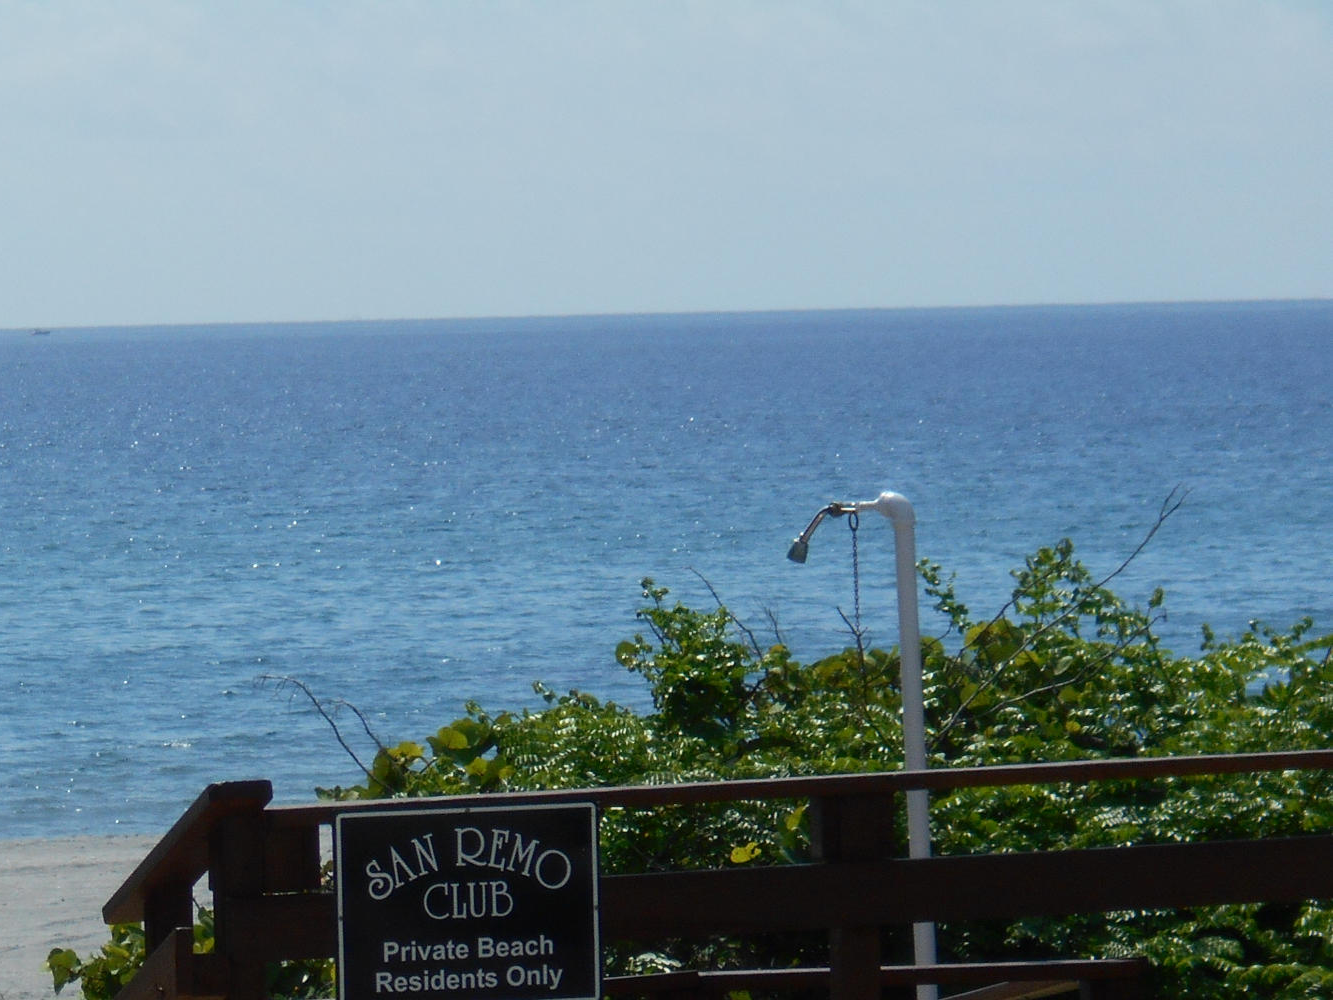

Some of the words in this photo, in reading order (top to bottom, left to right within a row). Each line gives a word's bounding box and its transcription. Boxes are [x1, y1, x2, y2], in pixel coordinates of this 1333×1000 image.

[366, 832, 439, 900] SAN
[454, 827, 572, 890] REMO
[423, 880, 514, 920] CLUB
[383, 940, 469, 963] Private
[477, 934, 554, 959] Beach
[375, 968, 498, 993] Residents
[506, 964, 563, 990] Only
